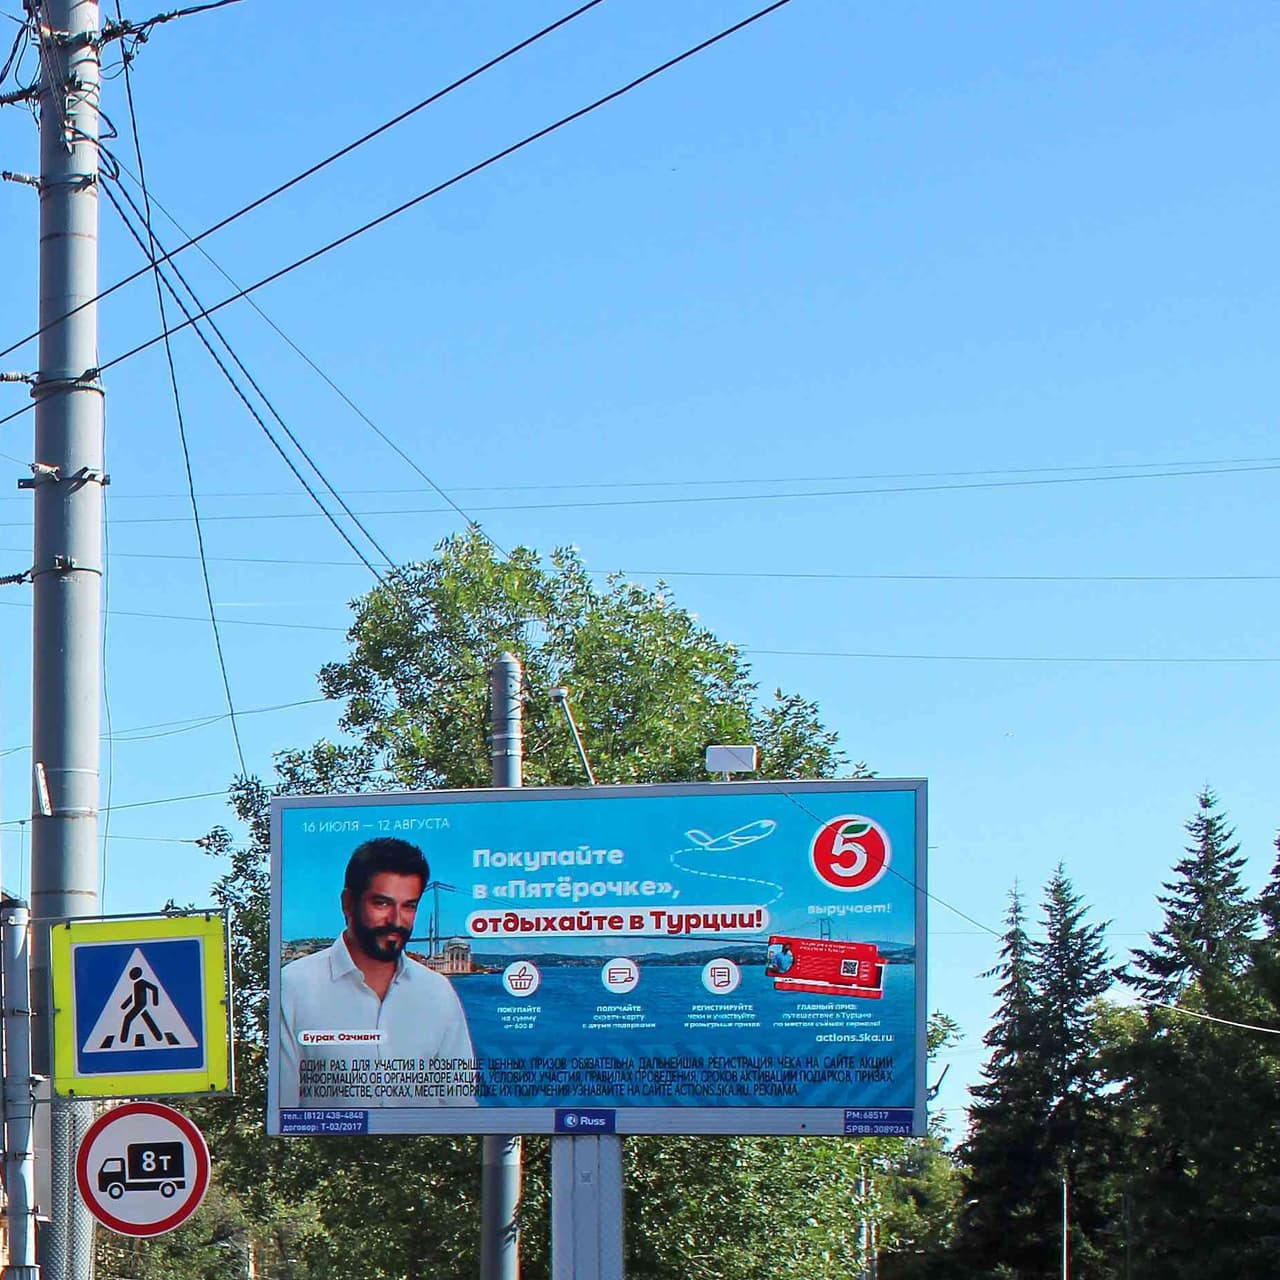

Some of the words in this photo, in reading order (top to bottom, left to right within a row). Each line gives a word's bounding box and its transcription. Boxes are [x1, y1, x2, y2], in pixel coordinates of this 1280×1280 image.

[302, 822, 316, 833] 16
[319, 821, 359, 833] ИЮЛЯ
[378, 820, 390, 831] 12
[393, 818, 451, 830] АВГУСТА
[830, 823, 871, 877] 5
[472, 844, 625, 872] Покупайте
[472, 884, 487, 898] в
[492, 876, 681, 902] «Пятёрочке»,
[807, 903, 892, 917] выручает!
[471, 910, 624, 933] отдыхайте
[629, 914, 644, 930] в
[650, 909, 762, 935] Турции!
[496, 1005, 542, 1013] ПОКУПАЙТЕ
[596, 1004, 642, 1012] ПОЛУЧАЙТЕ
[691, 1003, 753, 1011] РЕГИСТРИРУЙТЕ
[303, 1033, 335, 1043] Бурак
[338, 1033, 381, 1042] Озчивит
[815, 1032, 893, 1043] actions.5ka.ru
[299, 1059, 326, 1072] ОДИН
[351, 1059, 370, 1072] ДЛЯ
[374, 1058, 414, 1071] УЧАСТИЯ
[428, 1058, 483, 1071] РОЗЫГРЫШЕ
[531, 1057, 567, 1070] ПРИЗОВ
[571, 1057, 634, 1070] ОБЯЗАТЕЛЬНА
[708, 1056, 772, 1070] РЕГИСТРАЦИЯ
[778, 1057, 801, 1068] ЧЕКА
[807, 1057, 819, 1068] НА
[824, 1054, 855, 1068] САЙТЕ
[299, 1072, 368, 1085] ИНФОРМАЦИЮ
[370, 1072, 382, 1084] ОБ
[384, 1071, 451, 1084] ОРГАНИЗАТОРЕ
[584, 1071, 632, 1084] ПРАВИЛАХ
[741, 1070, 798, 1084] АКТИВАЦИИ
[299, 1085, 313, 1097] ИХ
[314, 1085, 372, 1099] КОЛИЧЕСТВЕ,
[374, 1085, 413, 1098] СРОКАХ,
[415, 1085, 445, 1097] МЕСТЕ
[455, 1084, 497, 1097] ПОРЯДКЕ
[627, 1083, 640, 1096] НА
[642, 1082, 672, 1096] САЙТЕ
[753, 1083, 799, 1096] РЕКЛАМА.
[303, 1111, 325, 1121] (812)
[579, 1116, 606, 1126] Russ
